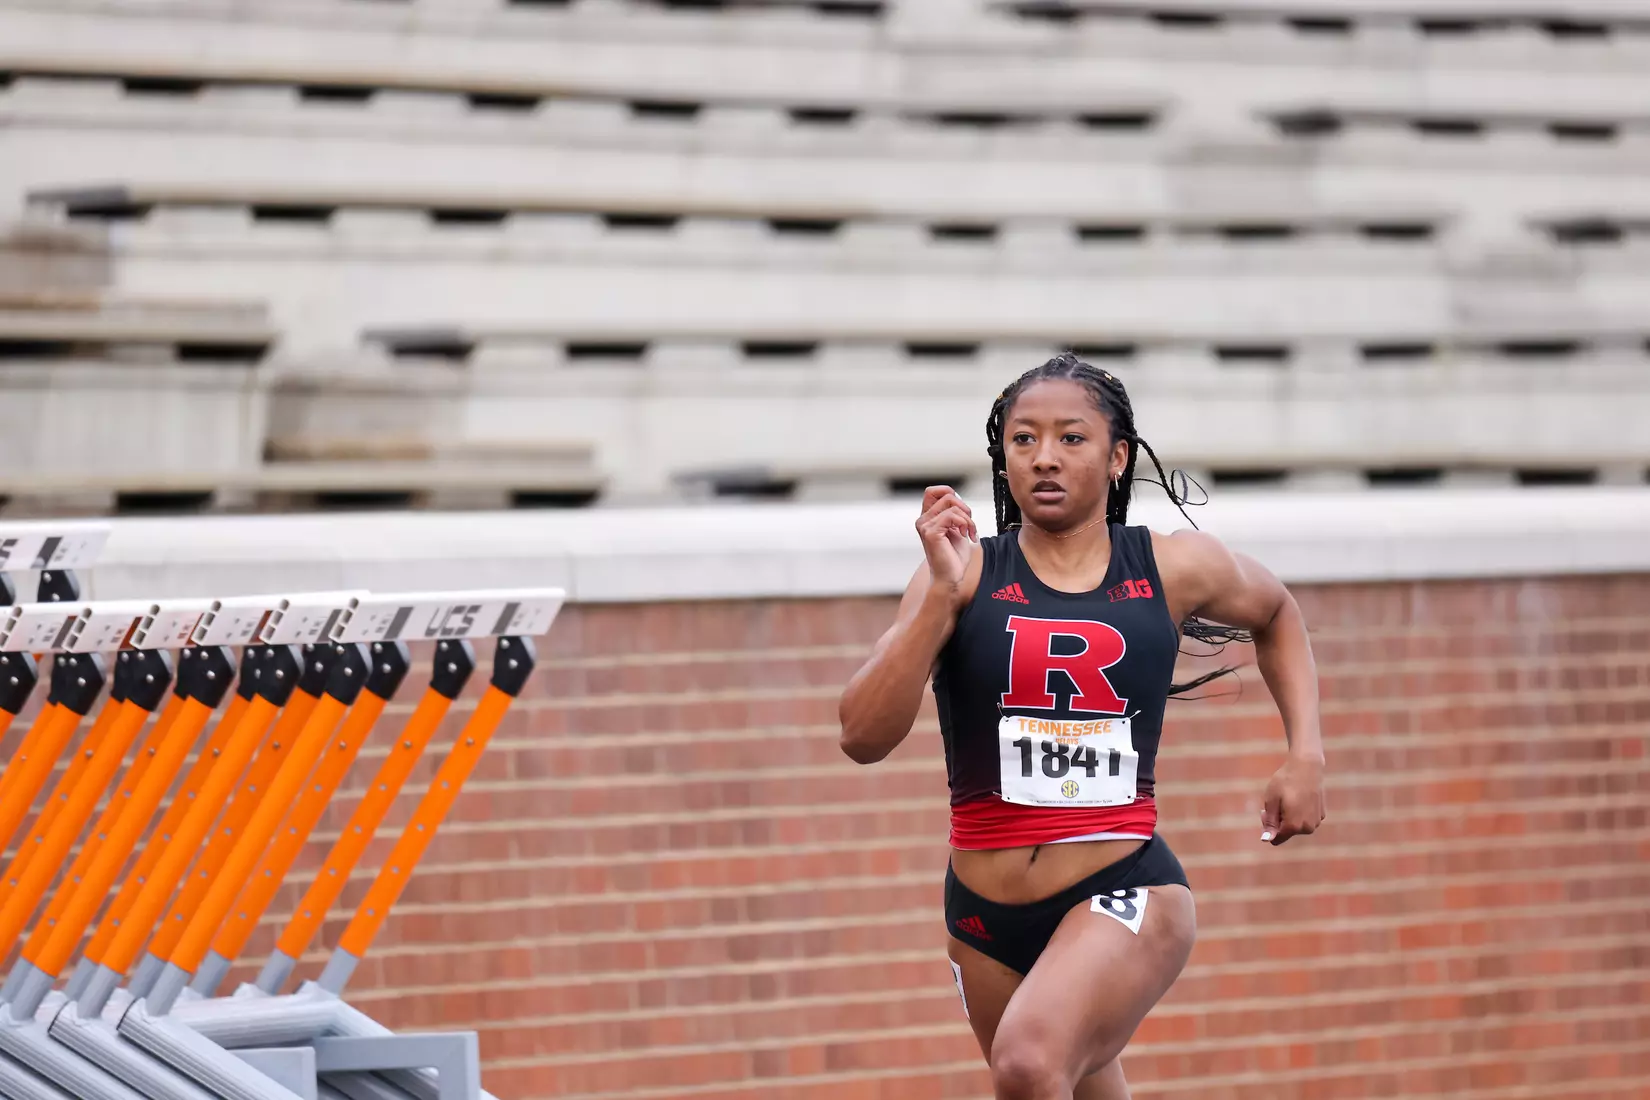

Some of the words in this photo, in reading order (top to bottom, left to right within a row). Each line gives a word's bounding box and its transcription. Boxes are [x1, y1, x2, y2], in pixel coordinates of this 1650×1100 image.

[991, 592, 1030, 605] adidas
[424, 604, 482, 637] UCS
[1001, 614, 1128, 716] R
[1018, 718, 1112, 737] TENNESSEE
[1012, 736, 1121, 778] 1841
[1061, 781, 1079, 797] SEC
[1099, 888, 1138, 921] 8
